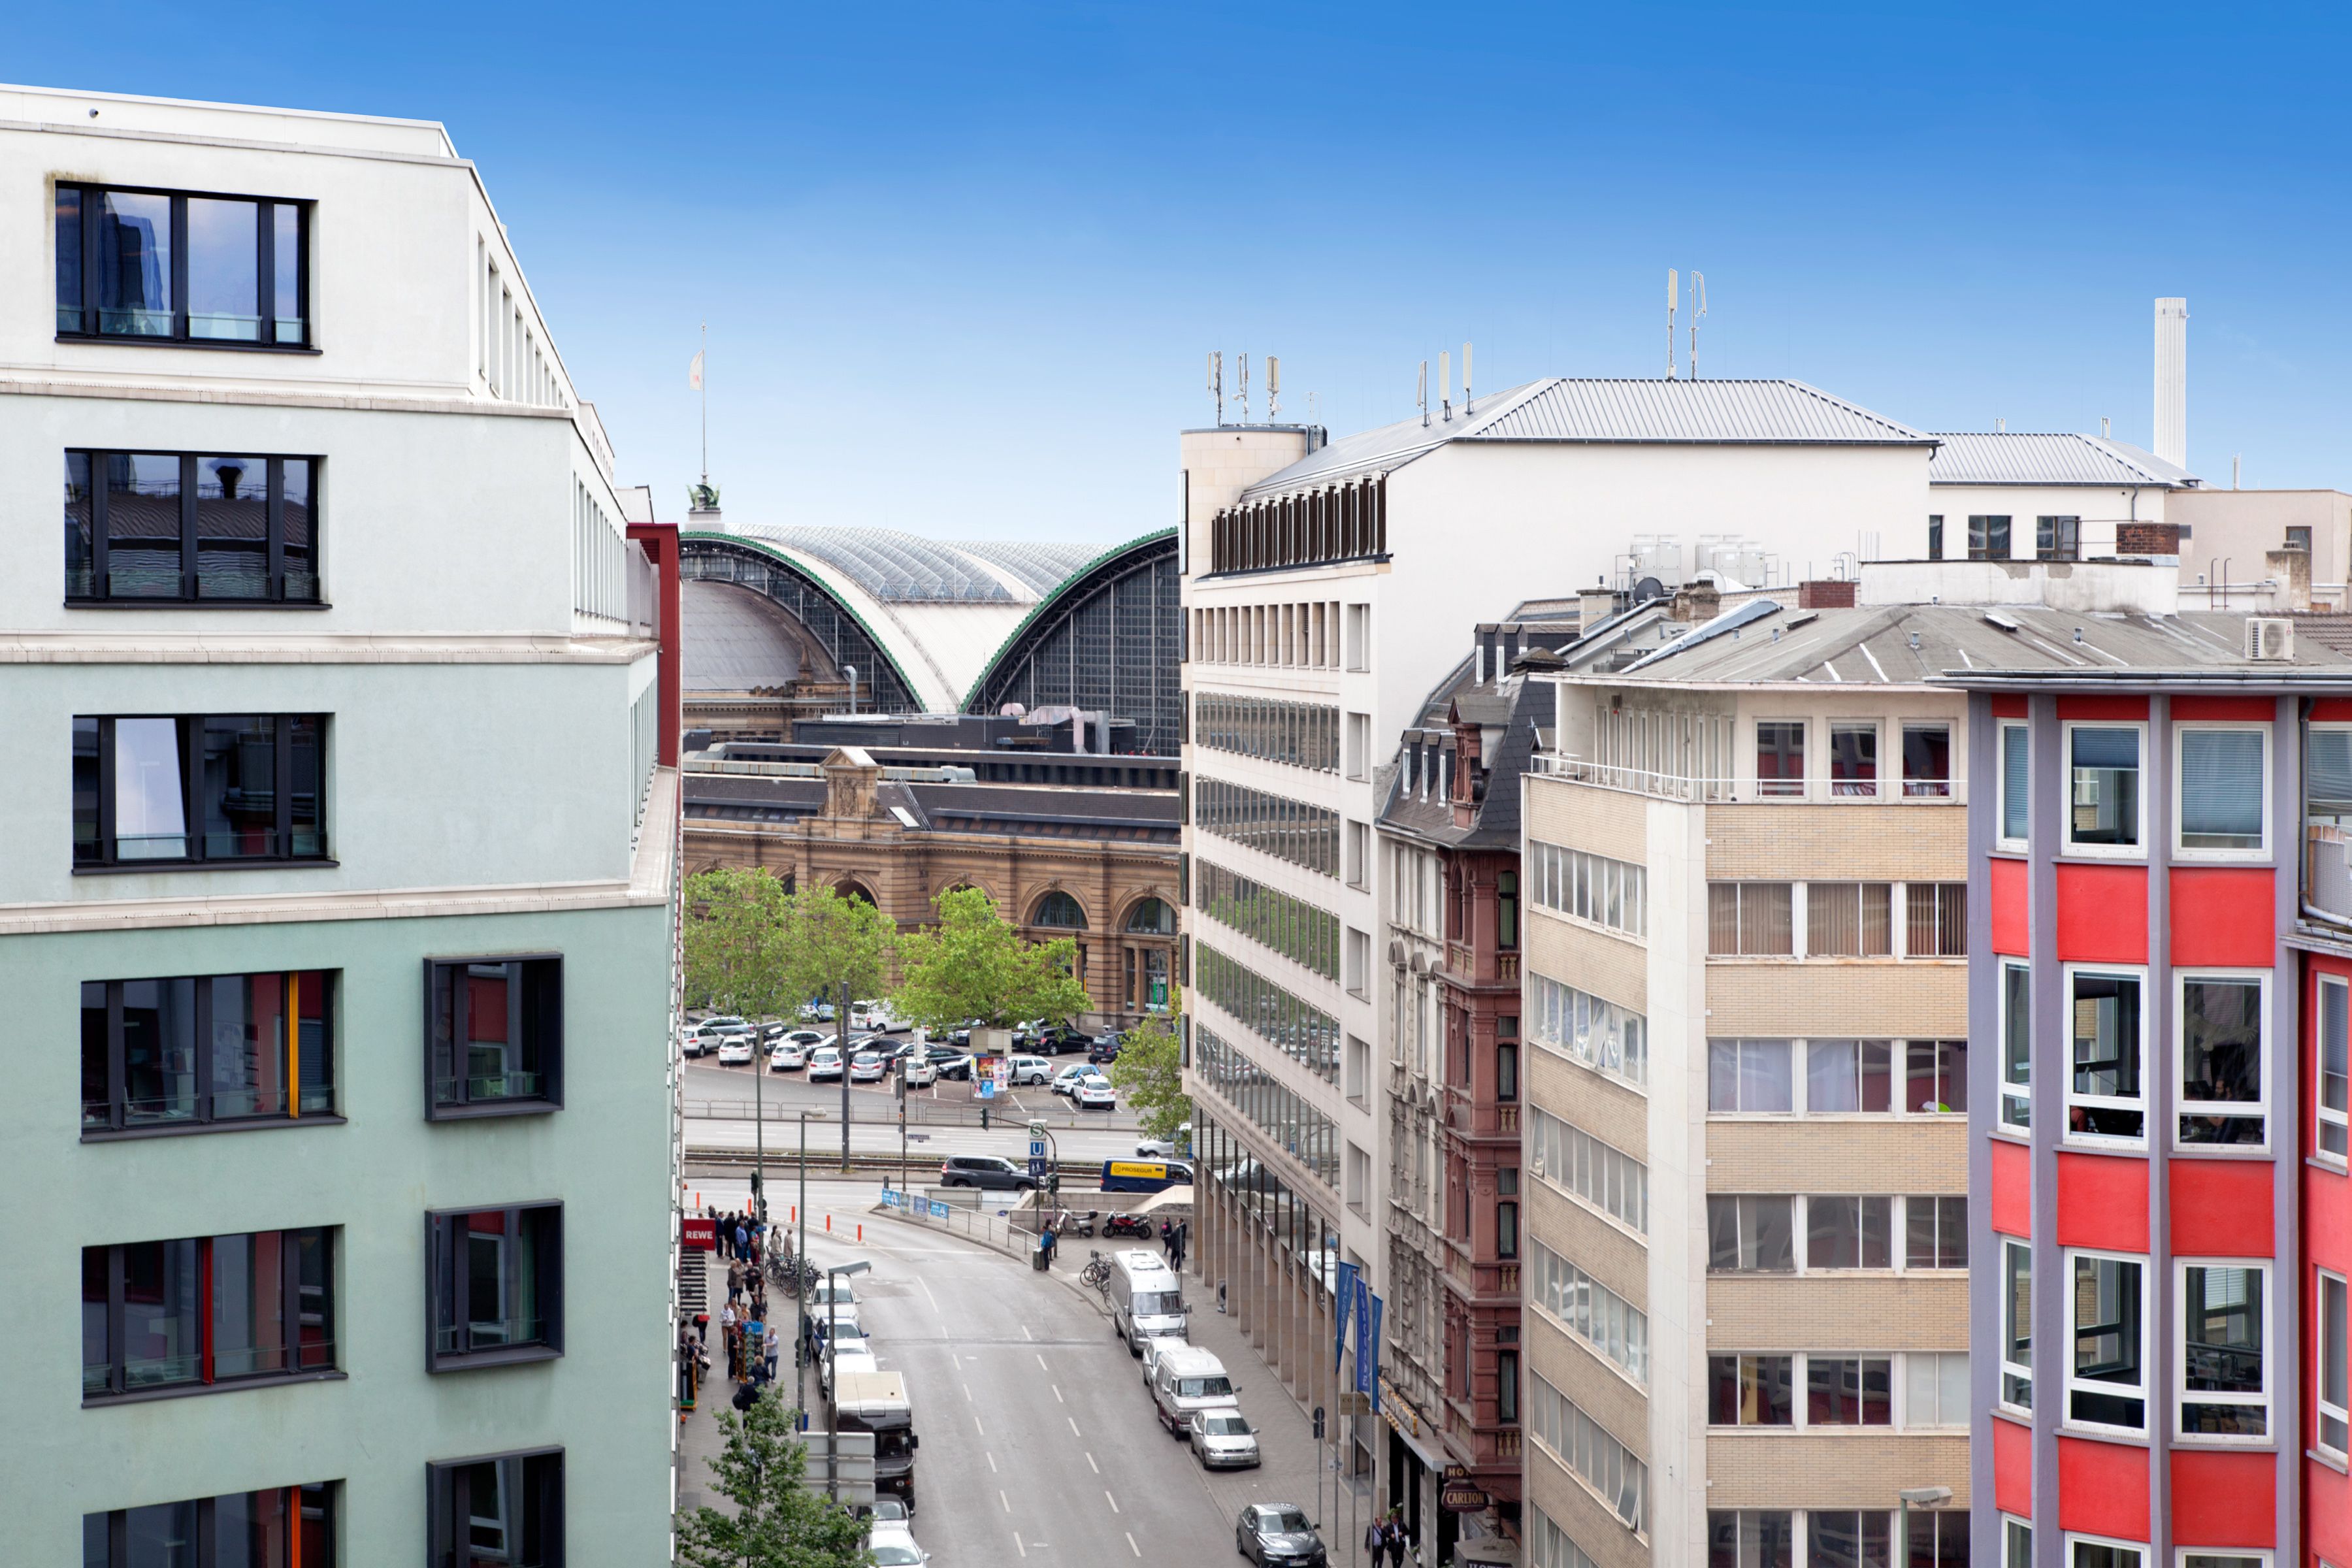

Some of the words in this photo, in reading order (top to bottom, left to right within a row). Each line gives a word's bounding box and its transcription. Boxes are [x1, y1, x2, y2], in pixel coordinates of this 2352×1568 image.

[1033, 1143, 1042, 1155] U
[685, 1230, 713, 1239] REWE
[1446, 1492, 1484, 1504] CARLTON
